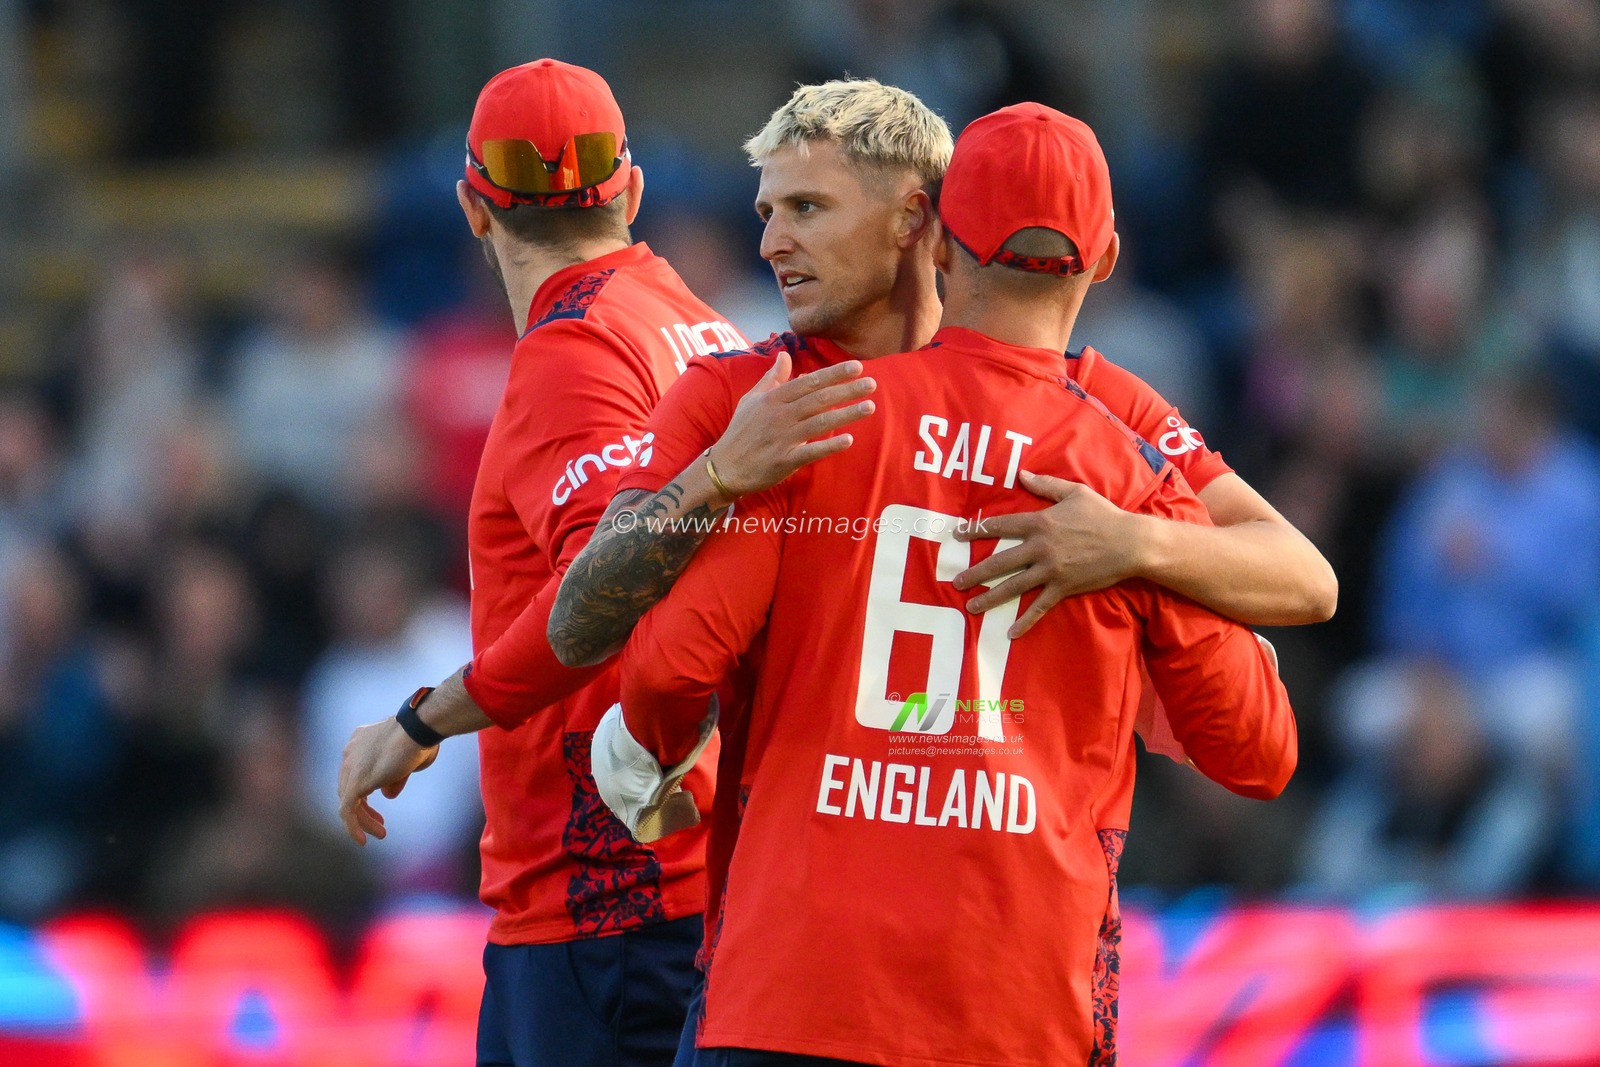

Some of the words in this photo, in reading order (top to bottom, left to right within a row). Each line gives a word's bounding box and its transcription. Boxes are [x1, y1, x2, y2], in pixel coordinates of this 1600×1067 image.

[913, 414, 1032, 489] SALT
[855, 503, 1026, 743] 61
[816, 753, 1037, 835] ENGLAND
